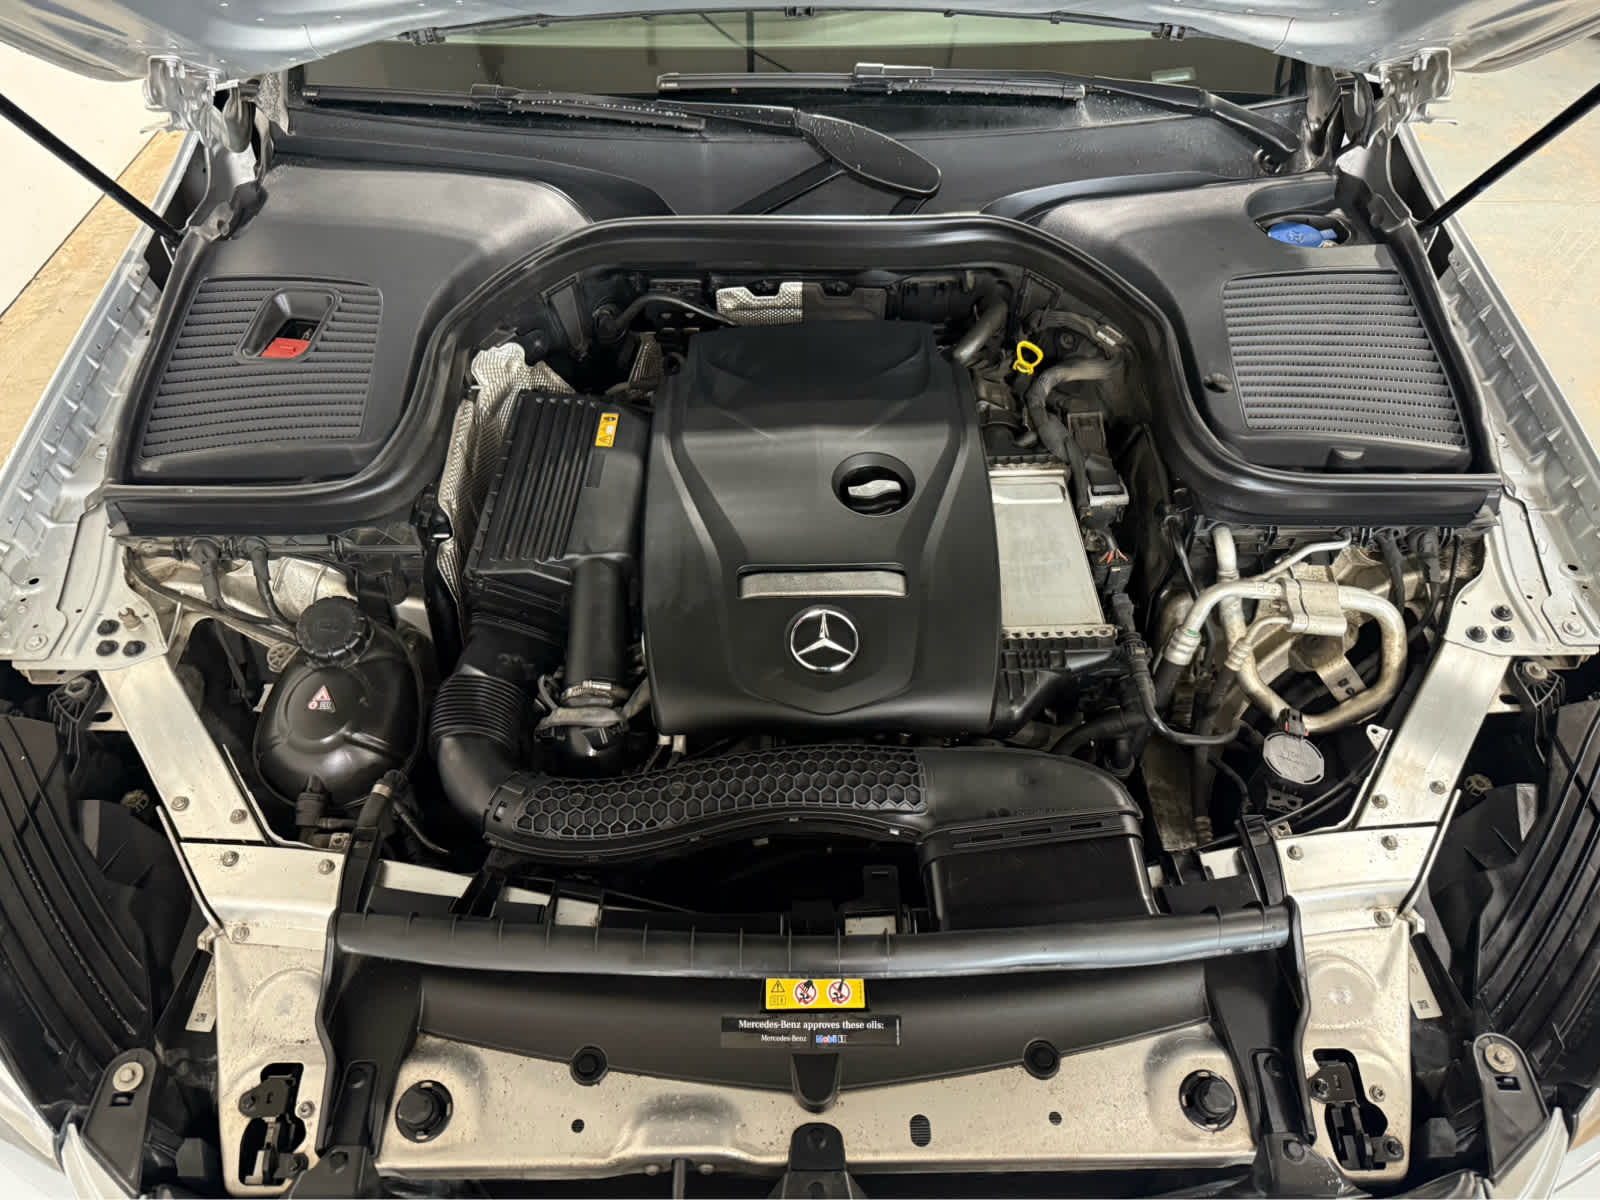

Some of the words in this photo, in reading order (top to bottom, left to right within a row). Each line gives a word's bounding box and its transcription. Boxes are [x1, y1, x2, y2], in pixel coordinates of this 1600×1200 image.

[738, 1019, 801, 1029] Mercedes-Benz
[803, 1020, 840, 1030] approves
[842, 1019, 864, 1029] these
[866, 1019, 884, 1029] oils:
[761, 1034, 807, 1042] Mercedes-Benz
[816, 1034, 837, 1043] Mobil
